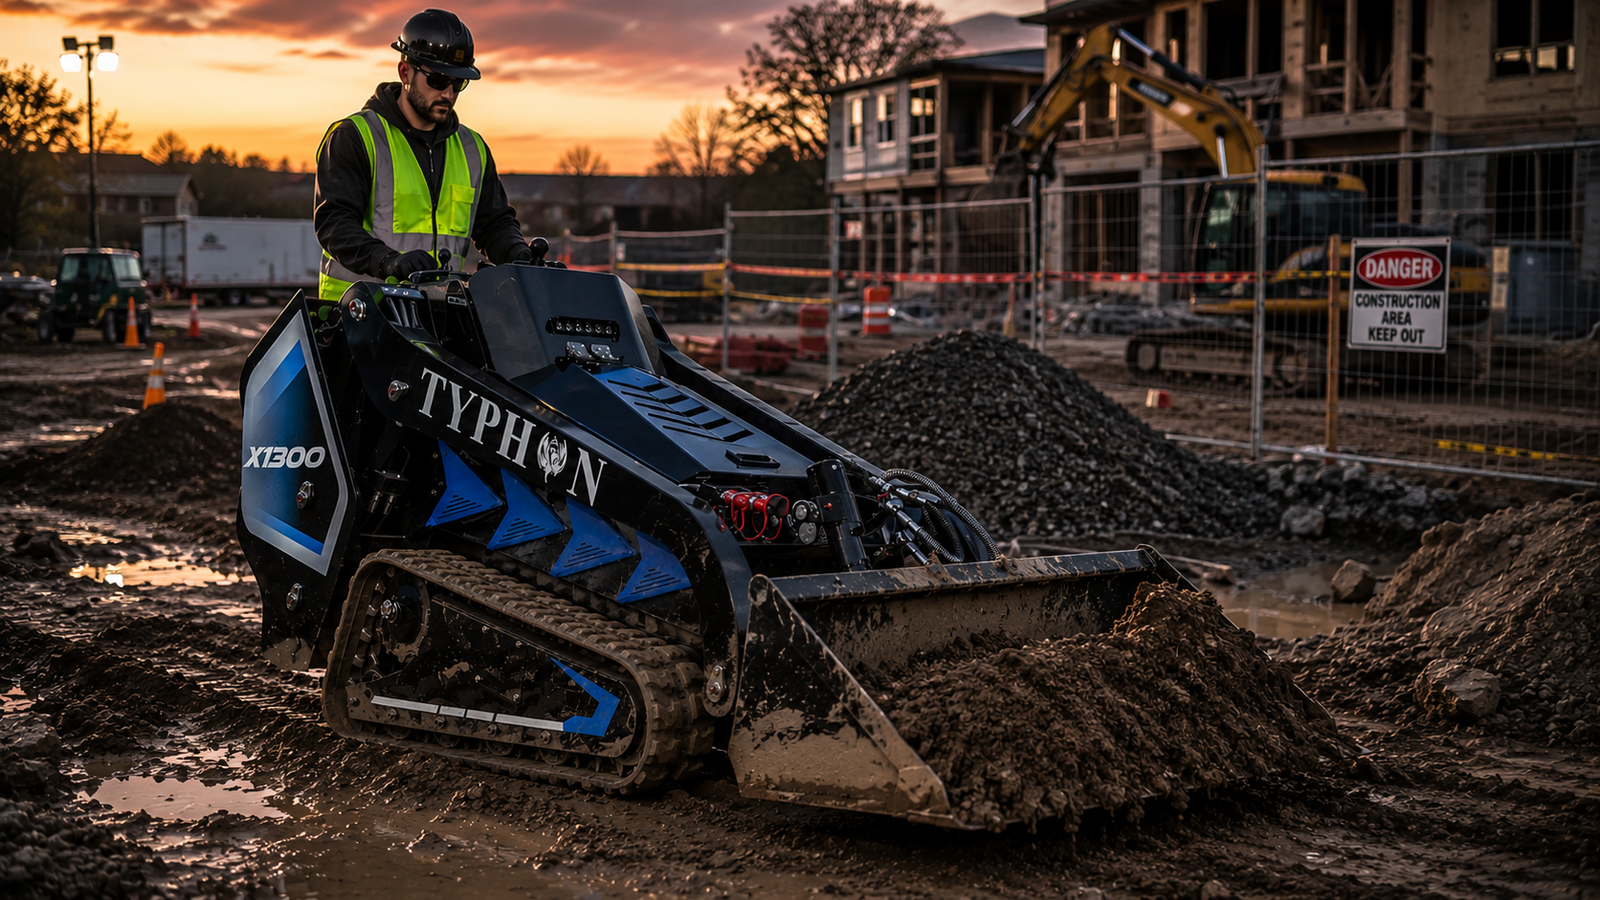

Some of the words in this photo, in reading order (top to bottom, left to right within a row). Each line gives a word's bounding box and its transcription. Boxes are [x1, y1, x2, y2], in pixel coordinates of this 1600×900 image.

[1365, 257, 1434, 279] DANGER
[1355, 293, 1441, 309] CONSTRUCTION
[1381, 310, 1412, 326] AREA
[1368, 326, 1397, 342] KEEP
[1400, 327, 1425, 344] OUT
[418, 367, 608, 507] TYPHON
[243, 446, 326, 469] X1300
